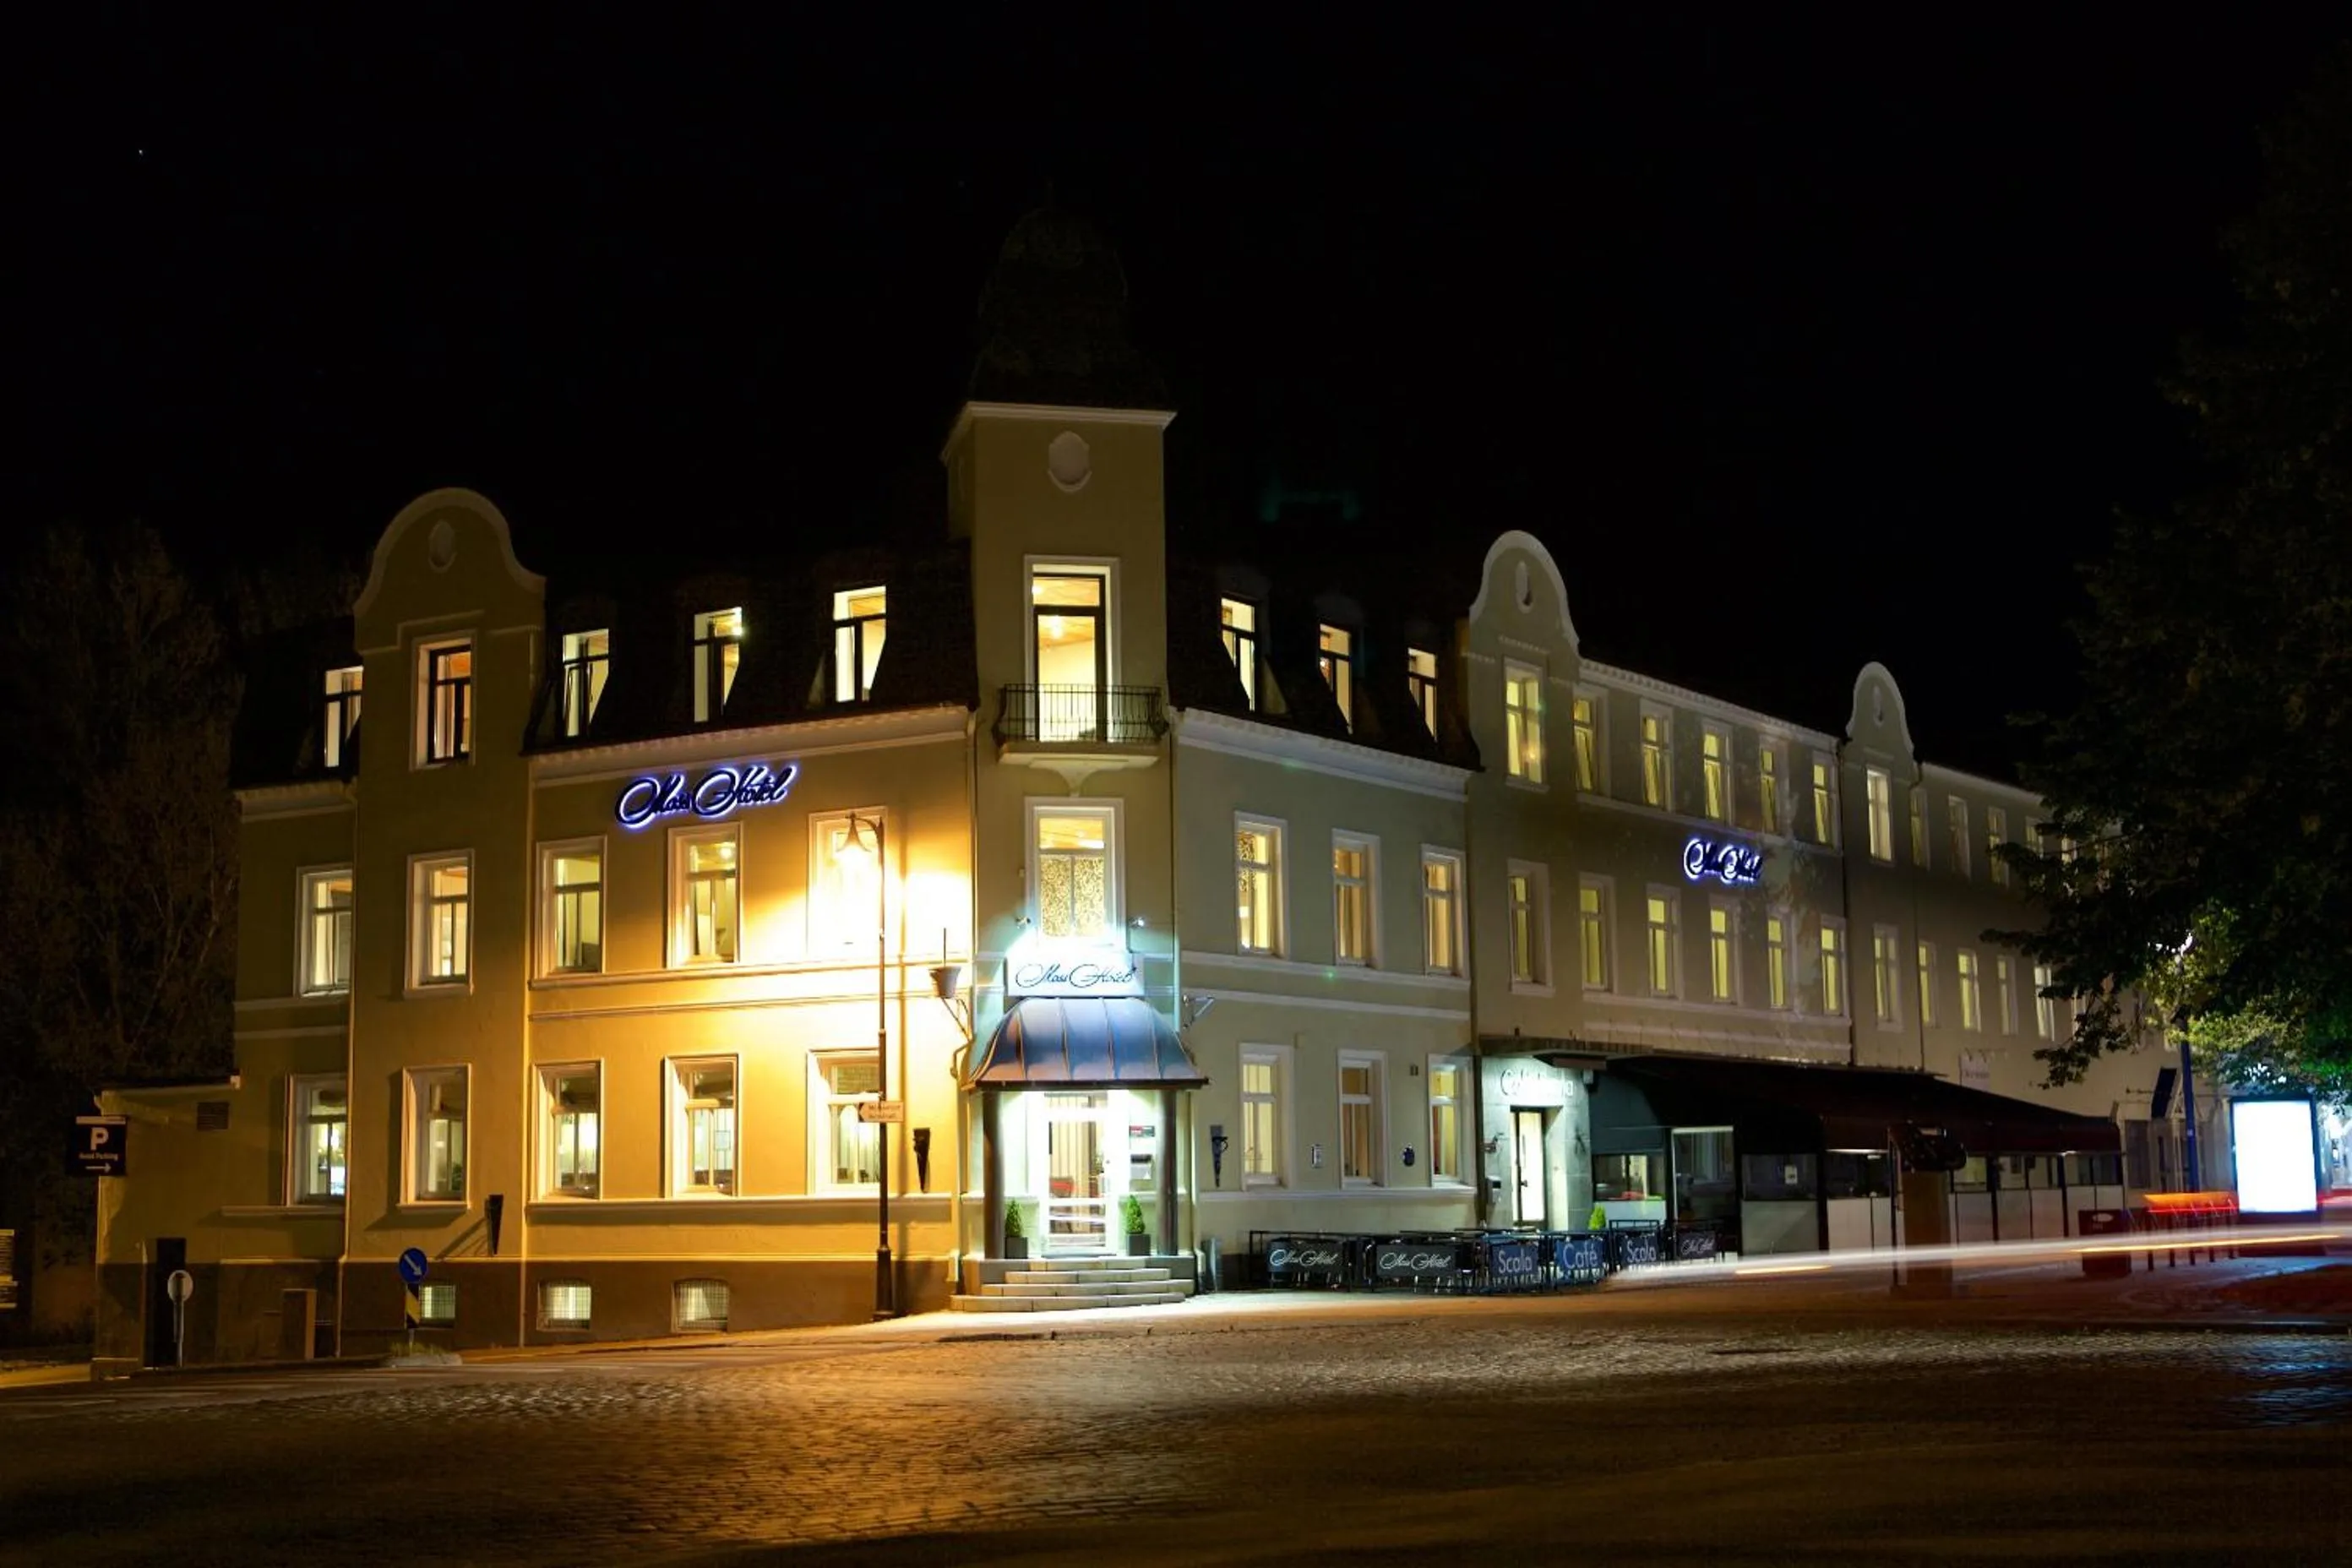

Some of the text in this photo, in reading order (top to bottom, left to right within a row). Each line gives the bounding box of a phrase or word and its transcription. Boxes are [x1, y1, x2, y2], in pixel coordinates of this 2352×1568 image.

[692, 764, 798, 819] Hotel
[1070, 963, 1135, 988] Hotel
[90, 1127, 110, 1151] P
[1411, 1252, 1451, 1271] Hotel
[1563, 1243, 1598, 1269] Café
